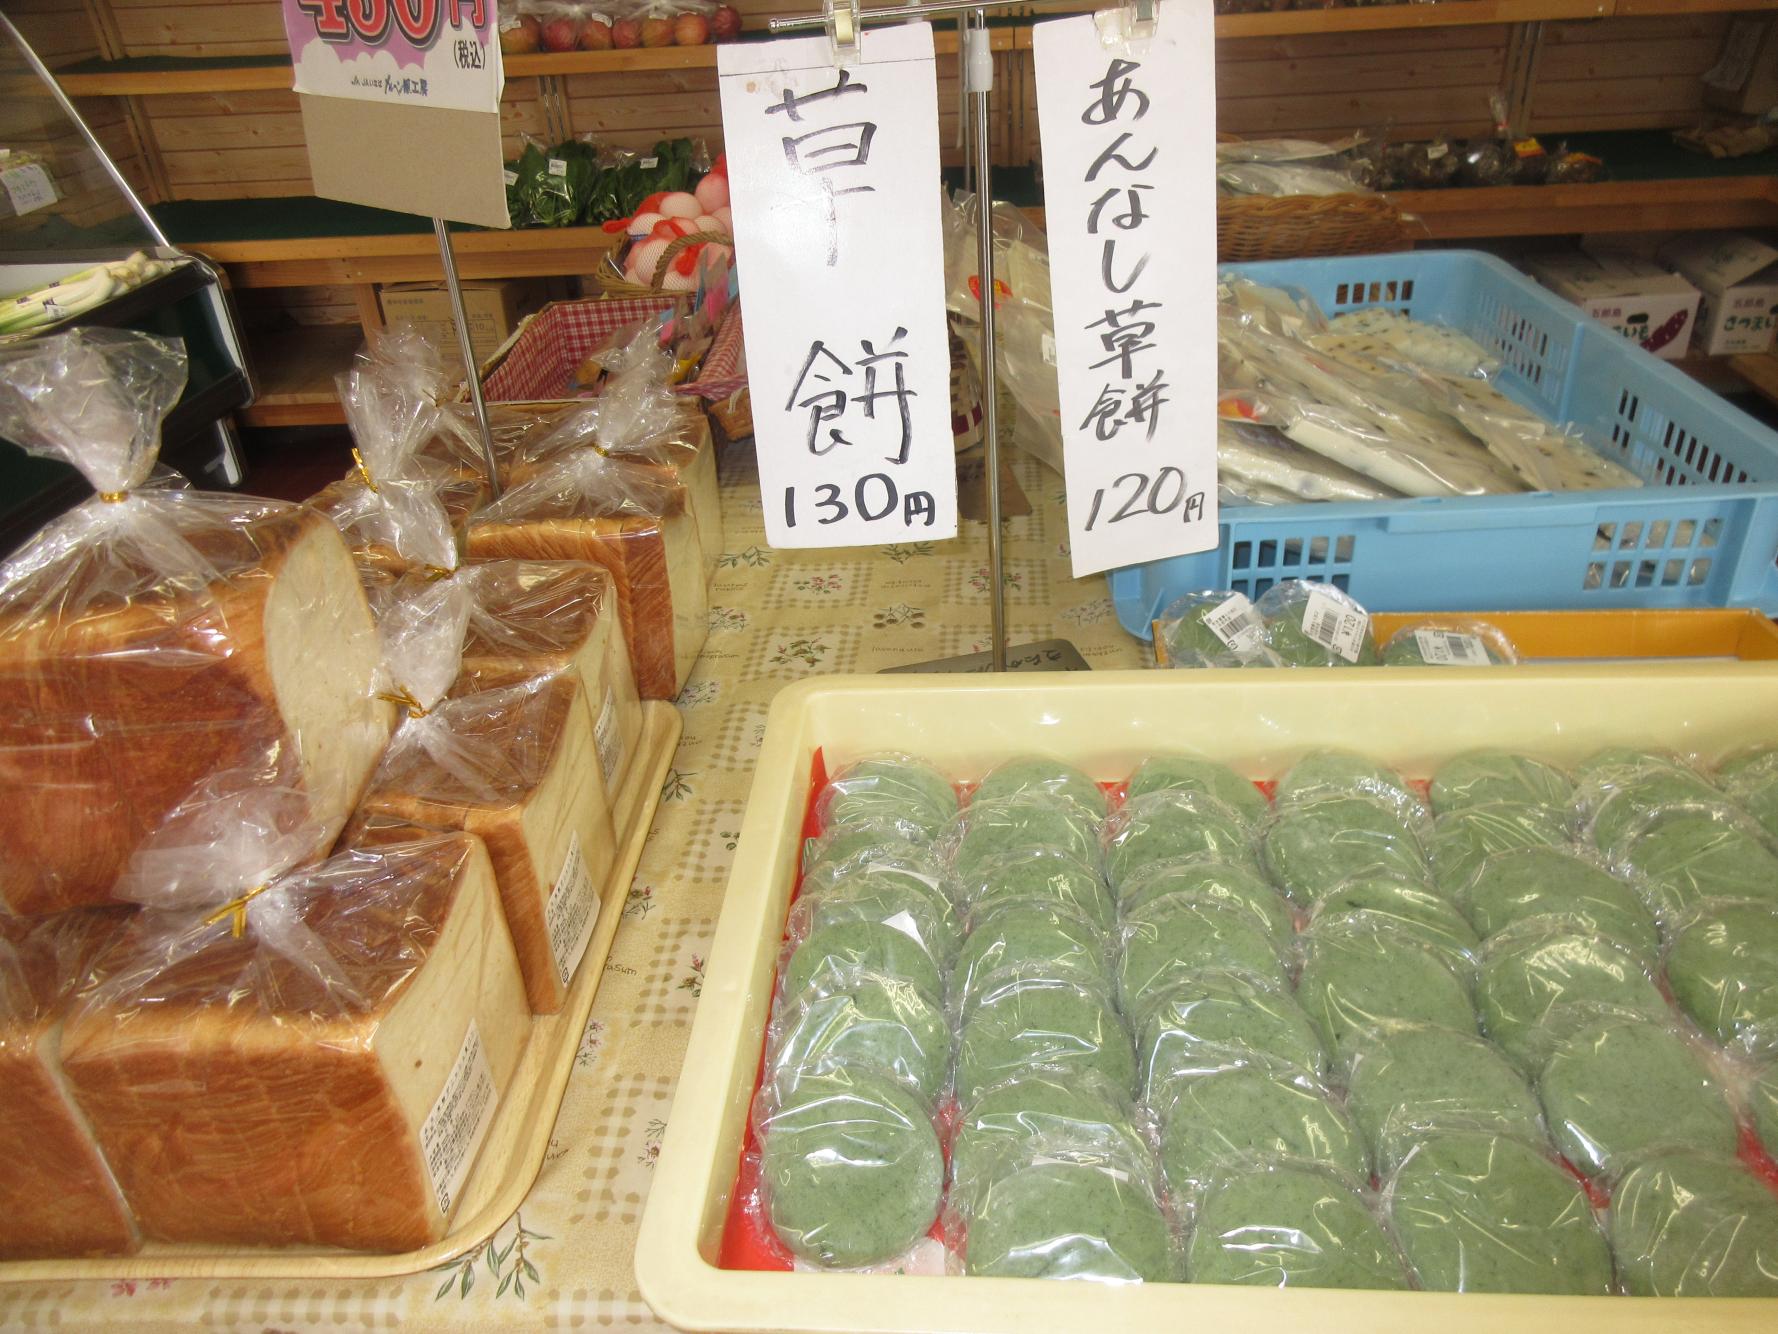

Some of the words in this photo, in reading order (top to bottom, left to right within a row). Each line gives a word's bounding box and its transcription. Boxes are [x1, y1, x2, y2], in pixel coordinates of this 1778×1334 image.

[453, 40, 486, 70] (税込)
[1081, 58, 1170, 442] あんなし草餅
[785, 473, 936, 528] 130円
[1085, 466, 1205, 532] 120円
